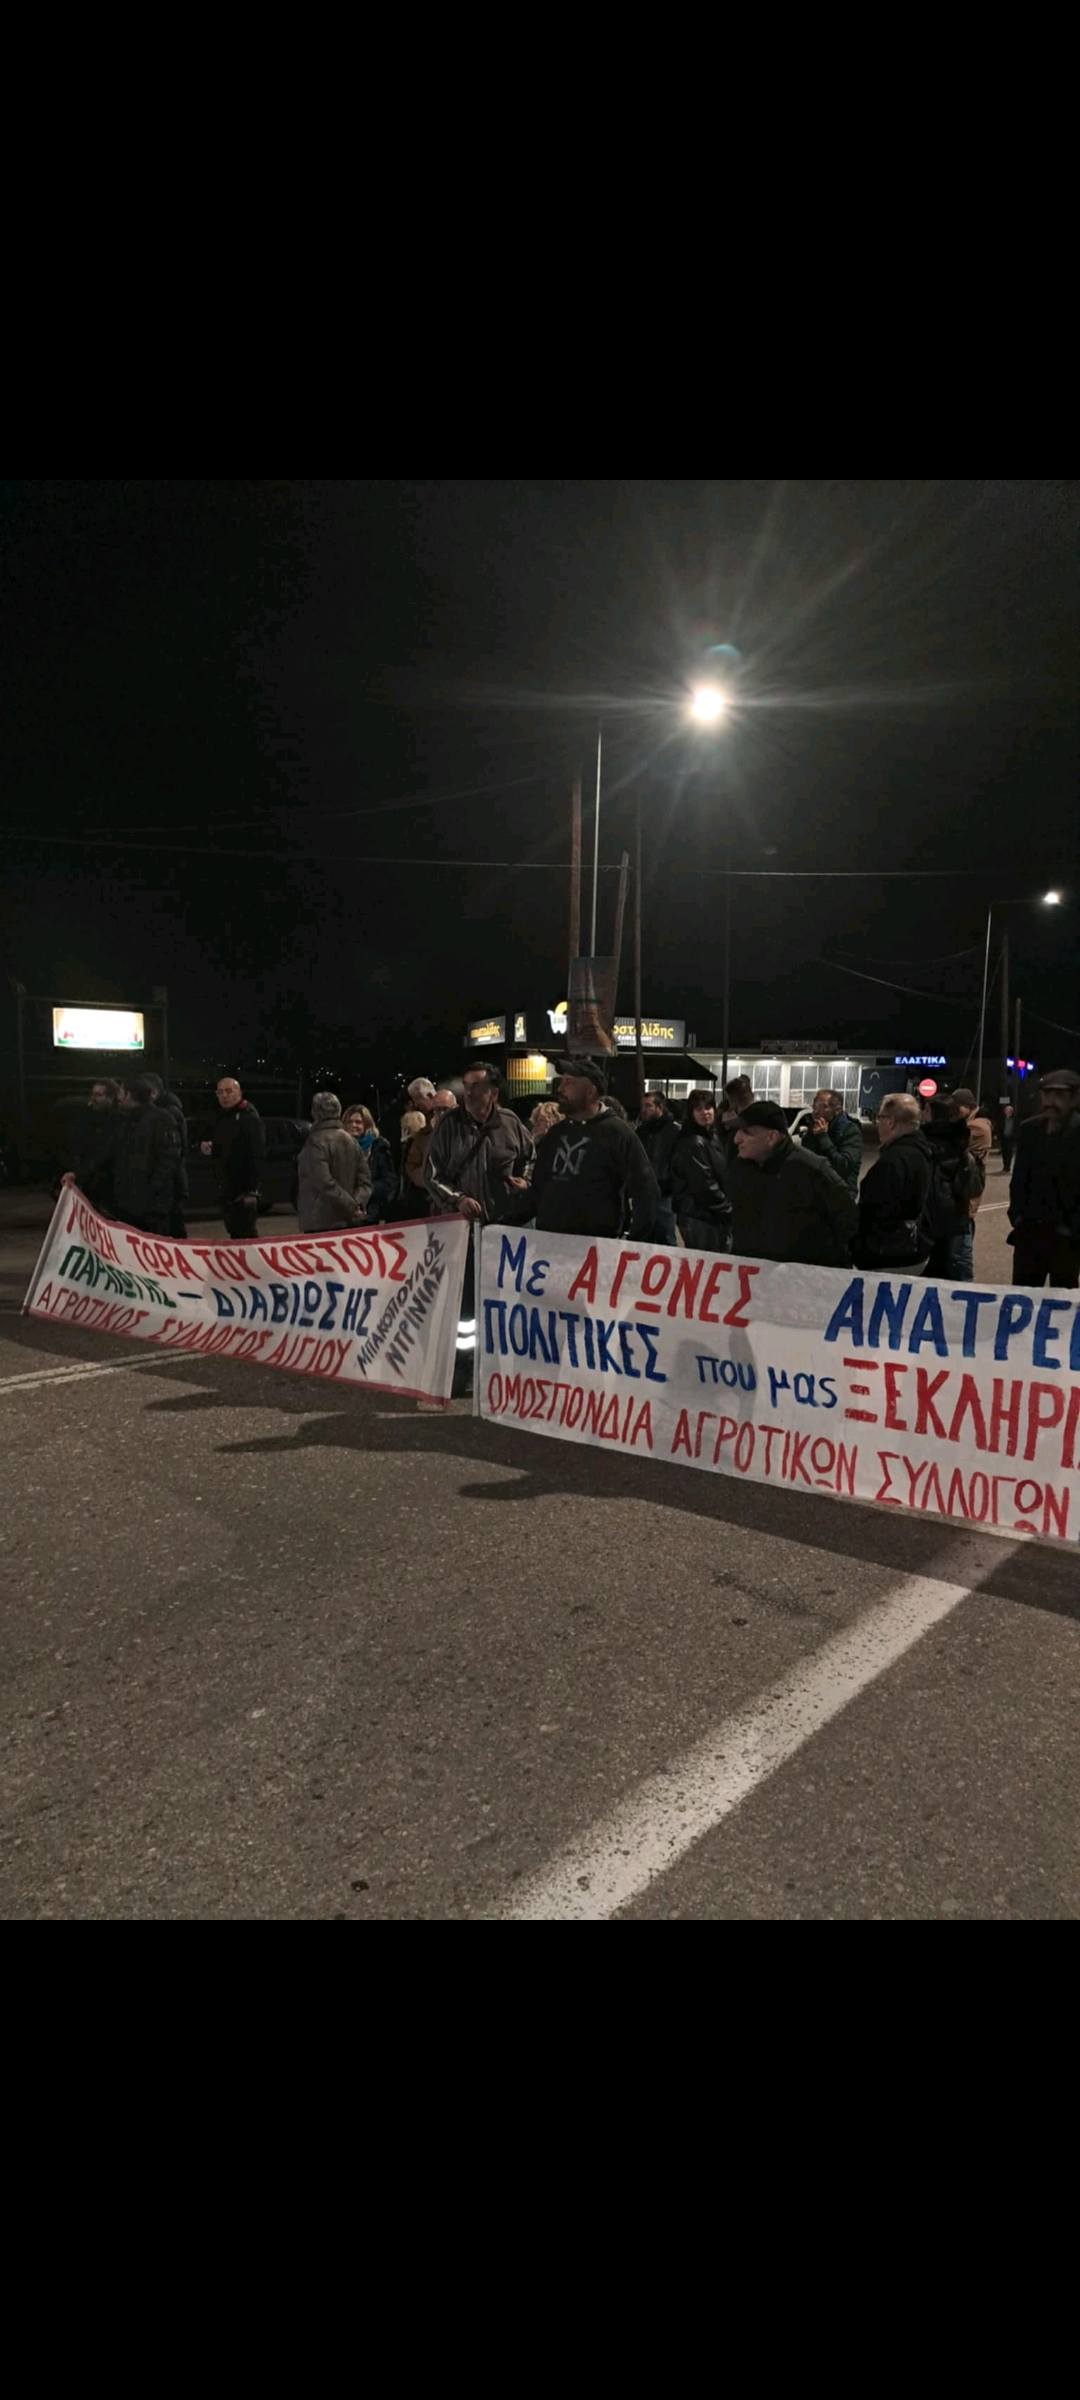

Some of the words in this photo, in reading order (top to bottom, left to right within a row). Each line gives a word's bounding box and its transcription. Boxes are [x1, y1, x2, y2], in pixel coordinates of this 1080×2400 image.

[895, 1055, 946, 1065] ΕΛΑΣΤΙΚΑ
[126, 1233, 205, 1282] ΤΩΡΑ
[192, 1246, 261, 1282] ΤΟΥ
[259, 1231, 409, 1283] ΚΟΣΤΟΥΣ
[497, 1234, 550, 1297] Με
[567, 1246, 760, 1328] ΑΓΩΝΕΣ
[36, 1281, 150, 1333] ΑΓΡΟΤΙΚΟΣ
[149, 1317, 274, 1360] ΣΥΛΛΟΓΟΣ
[266, 1333, 352, 1377] ΑΙΓΙΟΥ
[211, 1281, 378, 1337] ΔΙΑΒΙΩΣΗΣ
[483, 1299, 667, 1383] ΠΟΛΙΤΙΚΕΣ
[696, 1355, 758, 1392] που
[767, 1365, 838, 1408] μας
[487, 1372, 653, 1450] ΟΜΟΣΠΟΝΔΙΑ
[671, 1408, 858, 1496] ΑΓΡΟΤΙΚΩΝ
[876, 1450, 1070, 1539] ΣΥΛΛΟΓΩΝ
